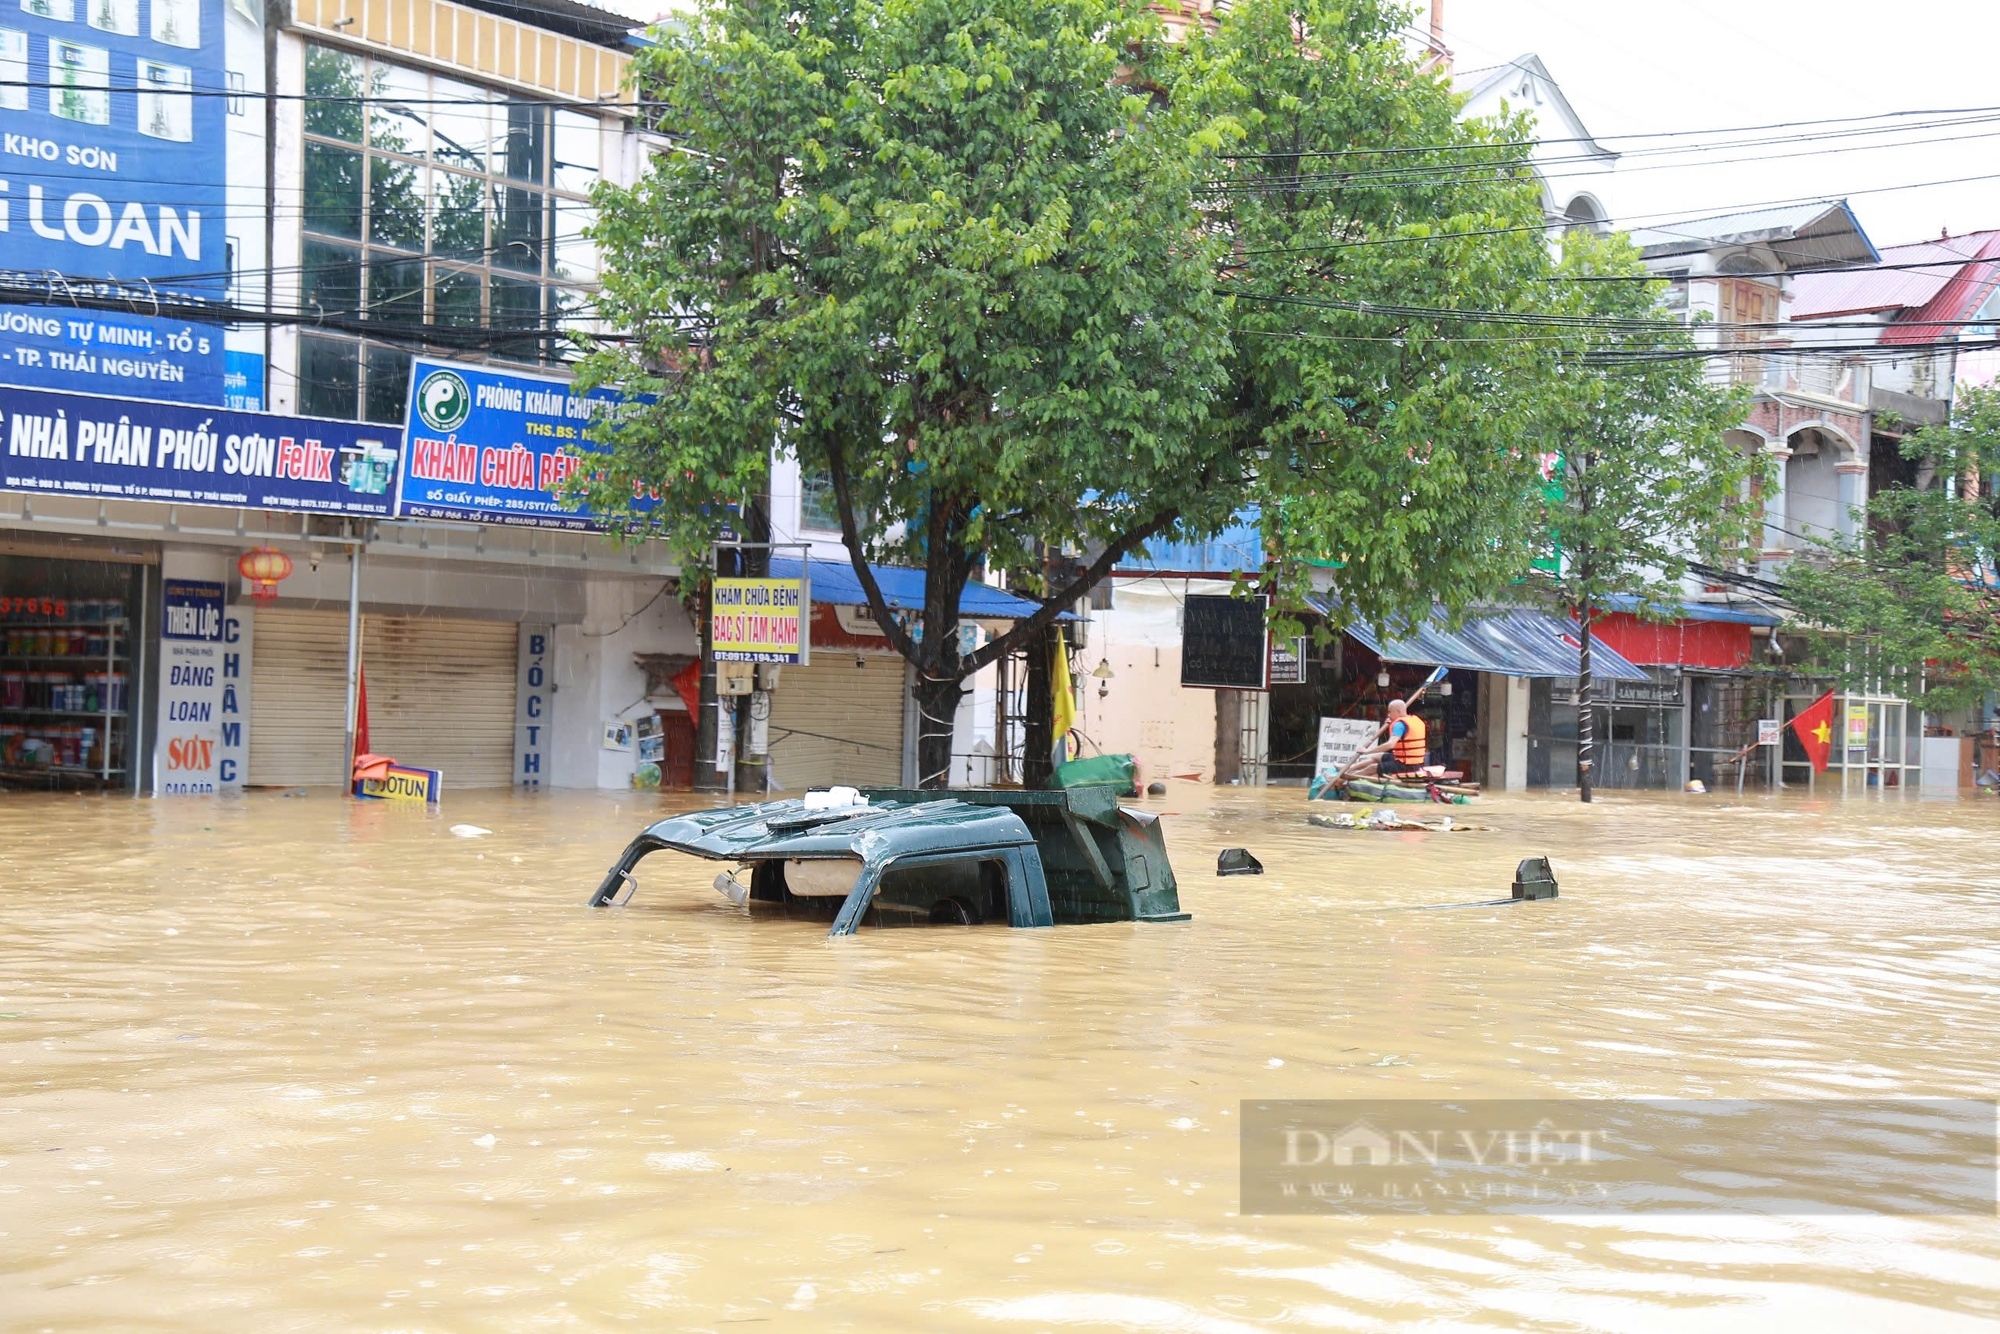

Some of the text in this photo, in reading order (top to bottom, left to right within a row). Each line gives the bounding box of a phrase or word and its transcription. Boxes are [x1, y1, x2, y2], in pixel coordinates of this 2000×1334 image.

[4, 133, 117, 172] KHO SƠN
[29, 185, 200, 261] LOAN
[68, 321, 94, 346] TỰ
[99, 327, 151, 348] MINH
[166, 327, 193, 353] TỔ
[198, 338, 210, 355] 5
[15, 348, 44, 368] TP.
[49, 350, 97, 373] THÁI
[103, 359, 184, 383] NGUYÊN
[476, 382, 522, 413] PHÒNG
[525, 389, 564, 417] KHÁM
[9, 409, 68, 460] NHÀ
[76, 415, 152, 469] PHÂN
[157, 418, 219, 473] PHỐI
[223, 432, 276, 478] SƠN
[276, 436, 335, 482] Felix
[526, 422, 577, 439] THS.BS:
[411, 436, 478, 484] KHÁM
[481, 442, 535, 490] CHỮA
[427, 488, 443, 501] SỐ
[445, 489, 472, 505] GIẤY
[715, 584, 798, 610] KHÁM CHỮA BỆNH
[199, 603, 219, 640] LỘC
[714, 611, 732, 641] BÁC
[771, 617, 798, 650] HẠNH
[170, 701, 211, 722] LOAN
[168, 734, 214, 771] SƠN
